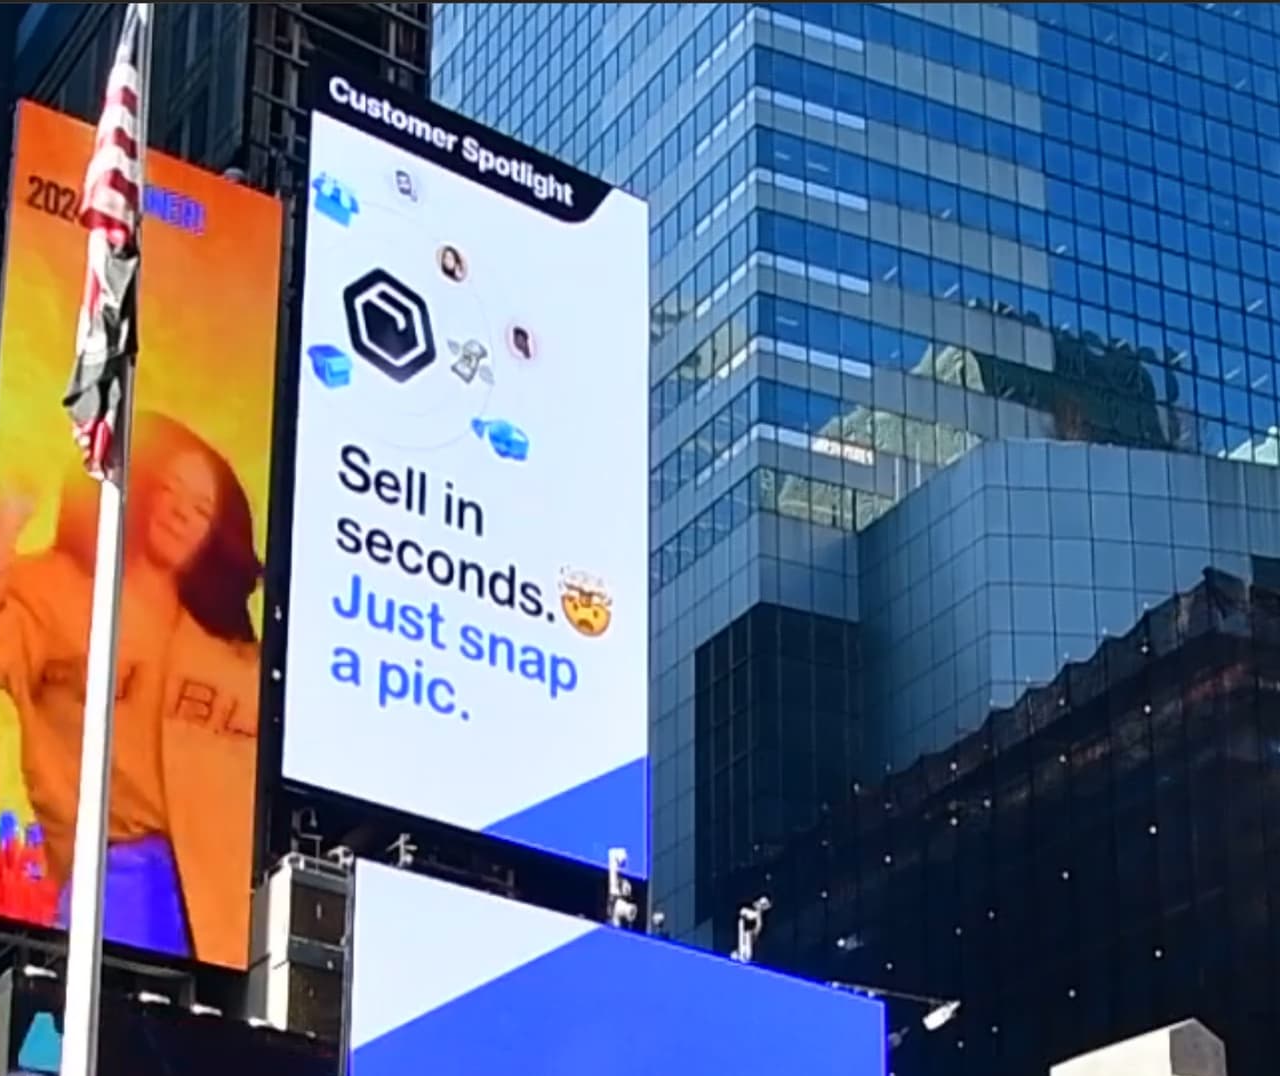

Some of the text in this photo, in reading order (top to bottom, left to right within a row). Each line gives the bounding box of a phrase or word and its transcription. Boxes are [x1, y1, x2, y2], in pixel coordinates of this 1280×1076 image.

[328, 76, 574, 206] Customer Spotlight
[27, 175, 81, 223] 202
[338, 444, 484, 537] Sell in
[336, 516, 556, 623] seconds.
[331, 646, 471, 722] a pic.
[333, 574, 578, 699] Just snap
